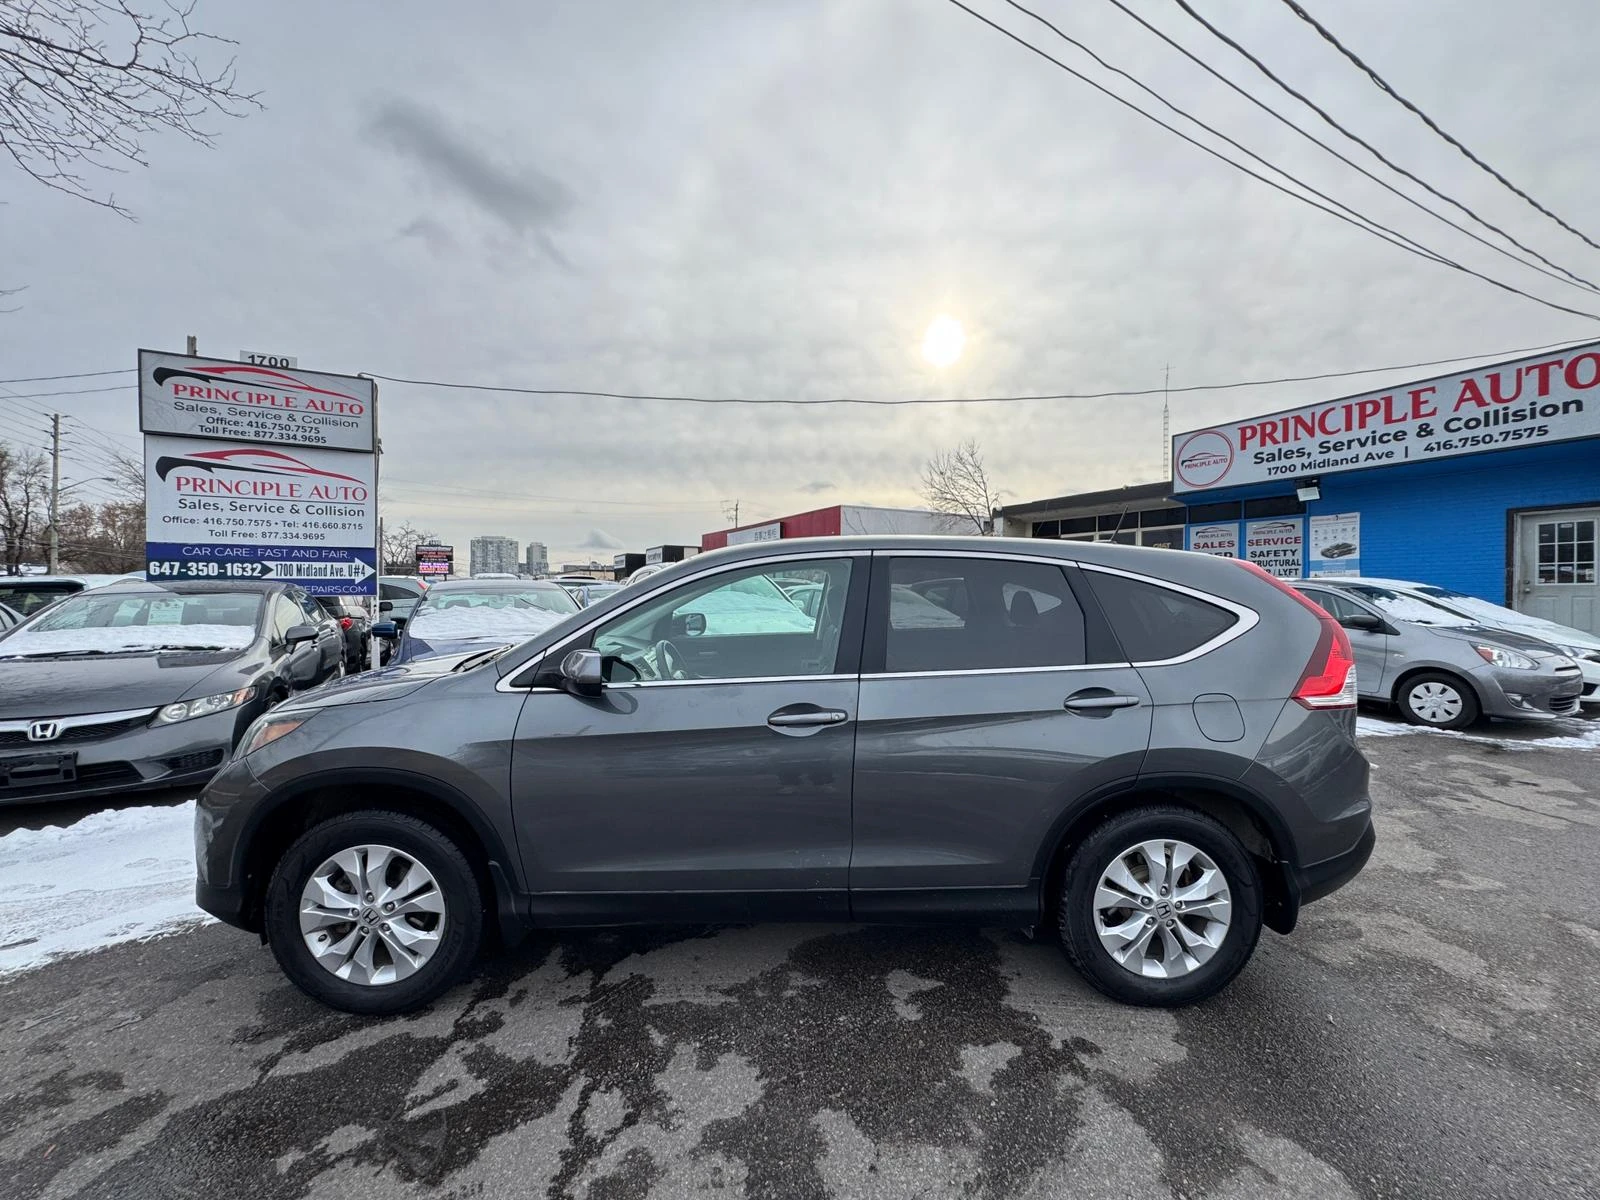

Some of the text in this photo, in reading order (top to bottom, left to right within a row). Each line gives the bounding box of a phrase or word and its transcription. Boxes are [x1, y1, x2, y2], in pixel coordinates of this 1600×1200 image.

[248, 354, 289, 368] 1700
[172, 383, 364, 415] PRINCIPLE AUTO
[1238, 352, 1600, 451] PRINCIPLE AUTO
[174, 401, 359, 428] Sales, Service & Collision
[206, 416, 320, 434] Office: 416.750.7575
[1253, 399, 1584, 464] Sales, Service & Collision
[198, 425, 327, 444] Toll Free: 877.334.9695
[1267, 463, 1297, 476] 1700
[1301, 454, 1359, 471] Midland
[1364, 450, 1394, 462] Ave
[1423, 425, 1549, 452] 416.750.7575
[1184, 460, 1211, 469] PRINCIPLE
[175, 476, 368, 501] PRINCIPLE AUTO
[178, 498, 365, 517] Sales, Service & Collision
[162, 515, 363, 530] Office: 416.750.7575 Tel: 416.660.8715
[208, 529, 326, 540] Toll Free: 877.334.9695
[1247, 536, 1302, 547] SERVICE
[182, 546, 211, 556] CAR
[257, 548, 288, 558] FAST
[291, 549, 318, 558] AND
[1193, 540, 1235, 550] SALES
[1250, 549, 1298, 558] SAFETY
[149, 561, 366, 577] 647-350-1632 1700 Midland Ave. U#4
[1278, 568, 1299, 576] LYFT
